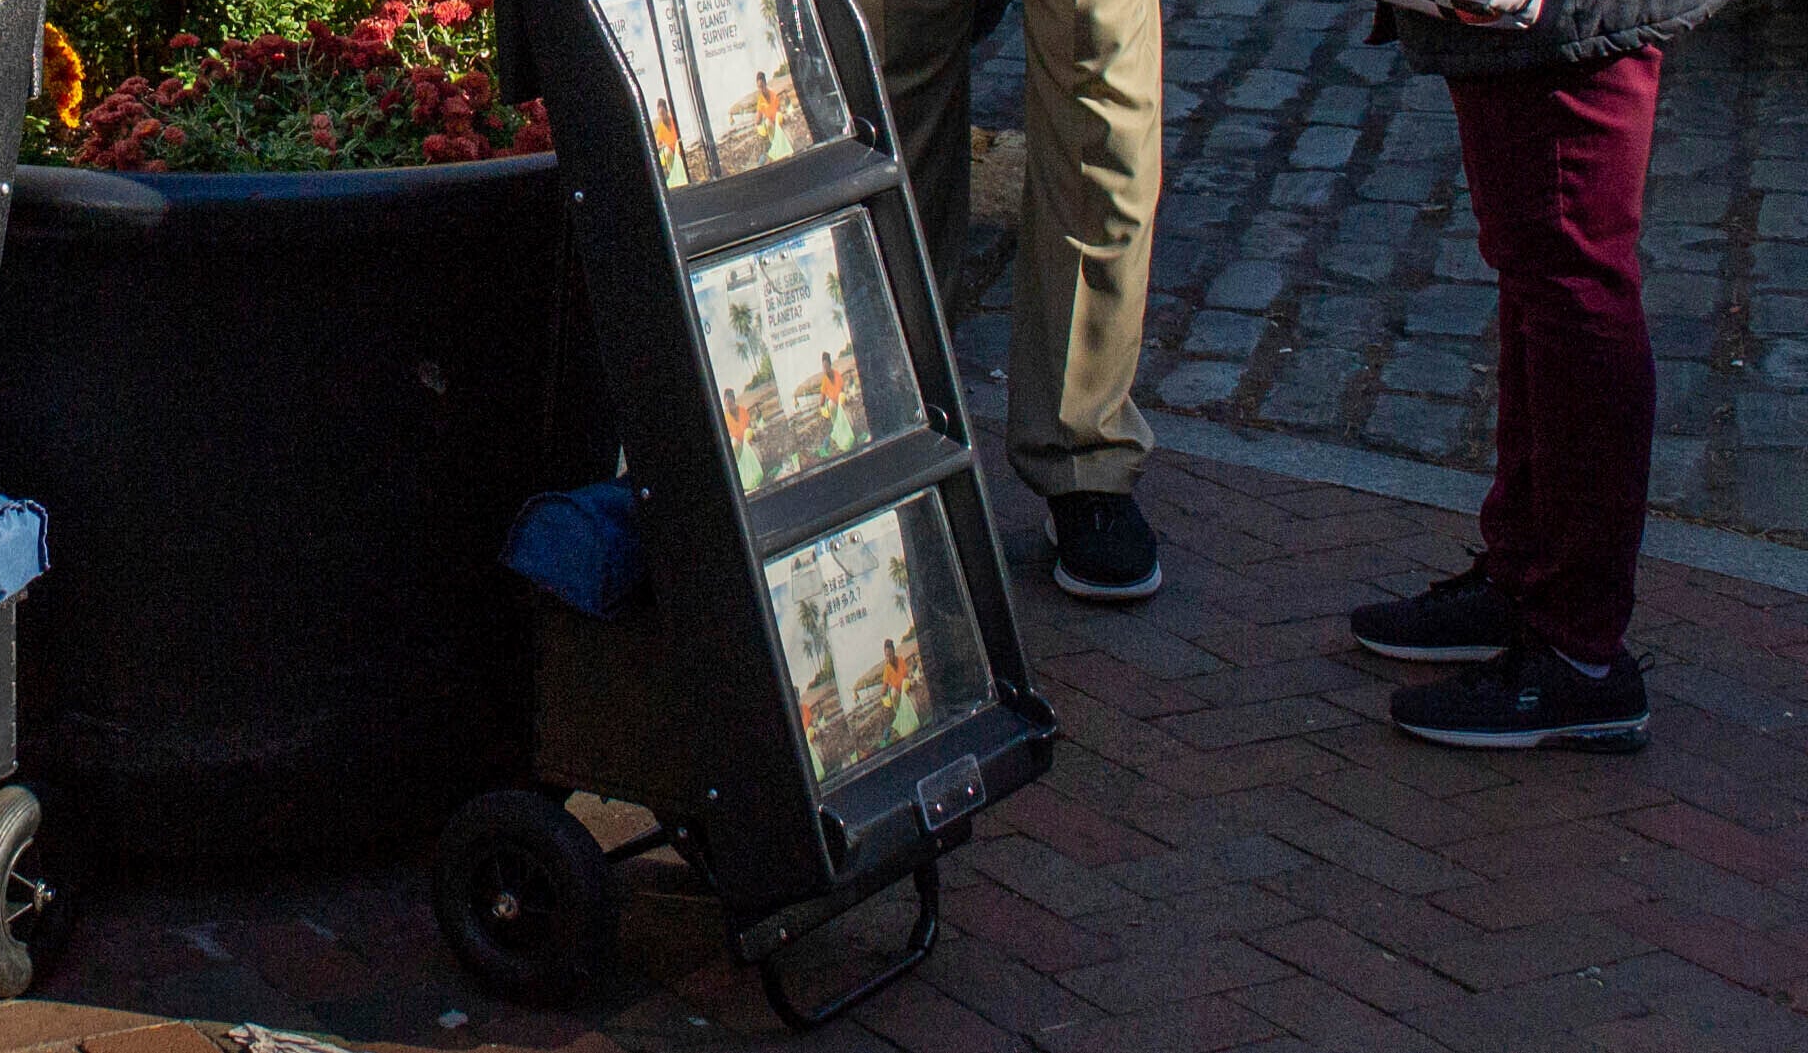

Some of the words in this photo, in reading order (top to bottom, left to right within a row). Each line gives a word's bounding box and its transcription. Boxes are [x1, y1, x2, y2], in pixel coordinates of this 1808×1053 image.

[699, 10, 728, 30] PLANET
[702, 24, 738, 46] SURVIVE?
[766, 298, 775, 312] DE
[776, 284, 811, 307] NUESTRO
[768, 304, 803, 328] PLANETA?
